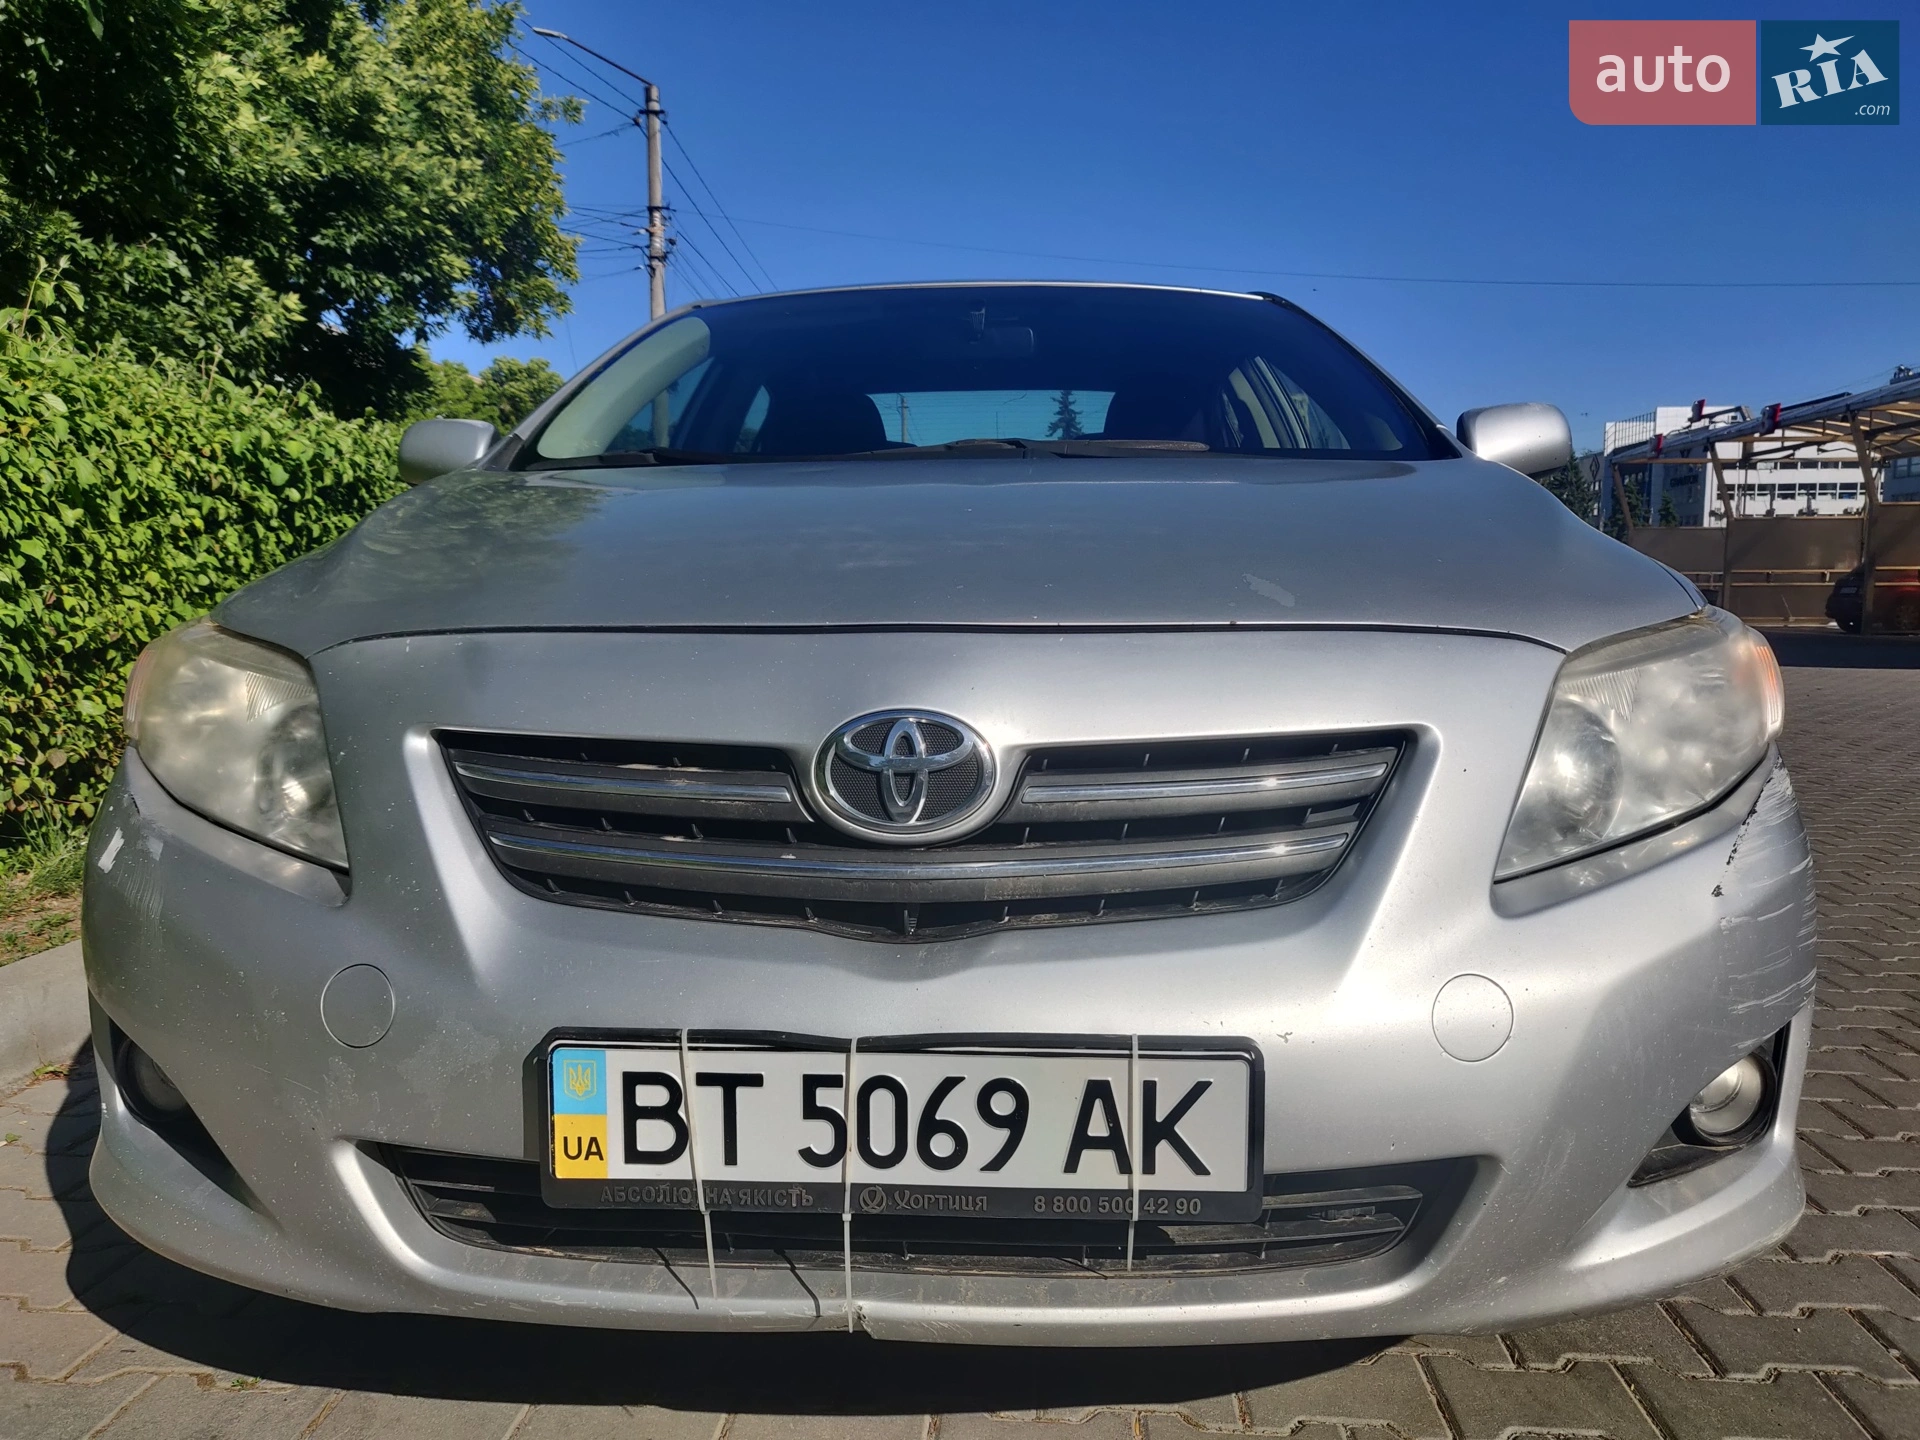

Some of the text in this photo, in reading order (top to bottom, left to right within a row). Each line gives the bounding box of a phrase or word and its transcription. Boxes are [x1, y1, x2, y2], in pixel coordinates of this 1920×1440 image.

[621, 1070, 1214, 1176] BT 5069 AK
[562, 1135, 604, 1161] UA
[600, 1184, 814, 1207] АБСОЛЮНА ЯКІСТЬ
[1033, 1195, 1202, 1215] 8 800 500 42 90
